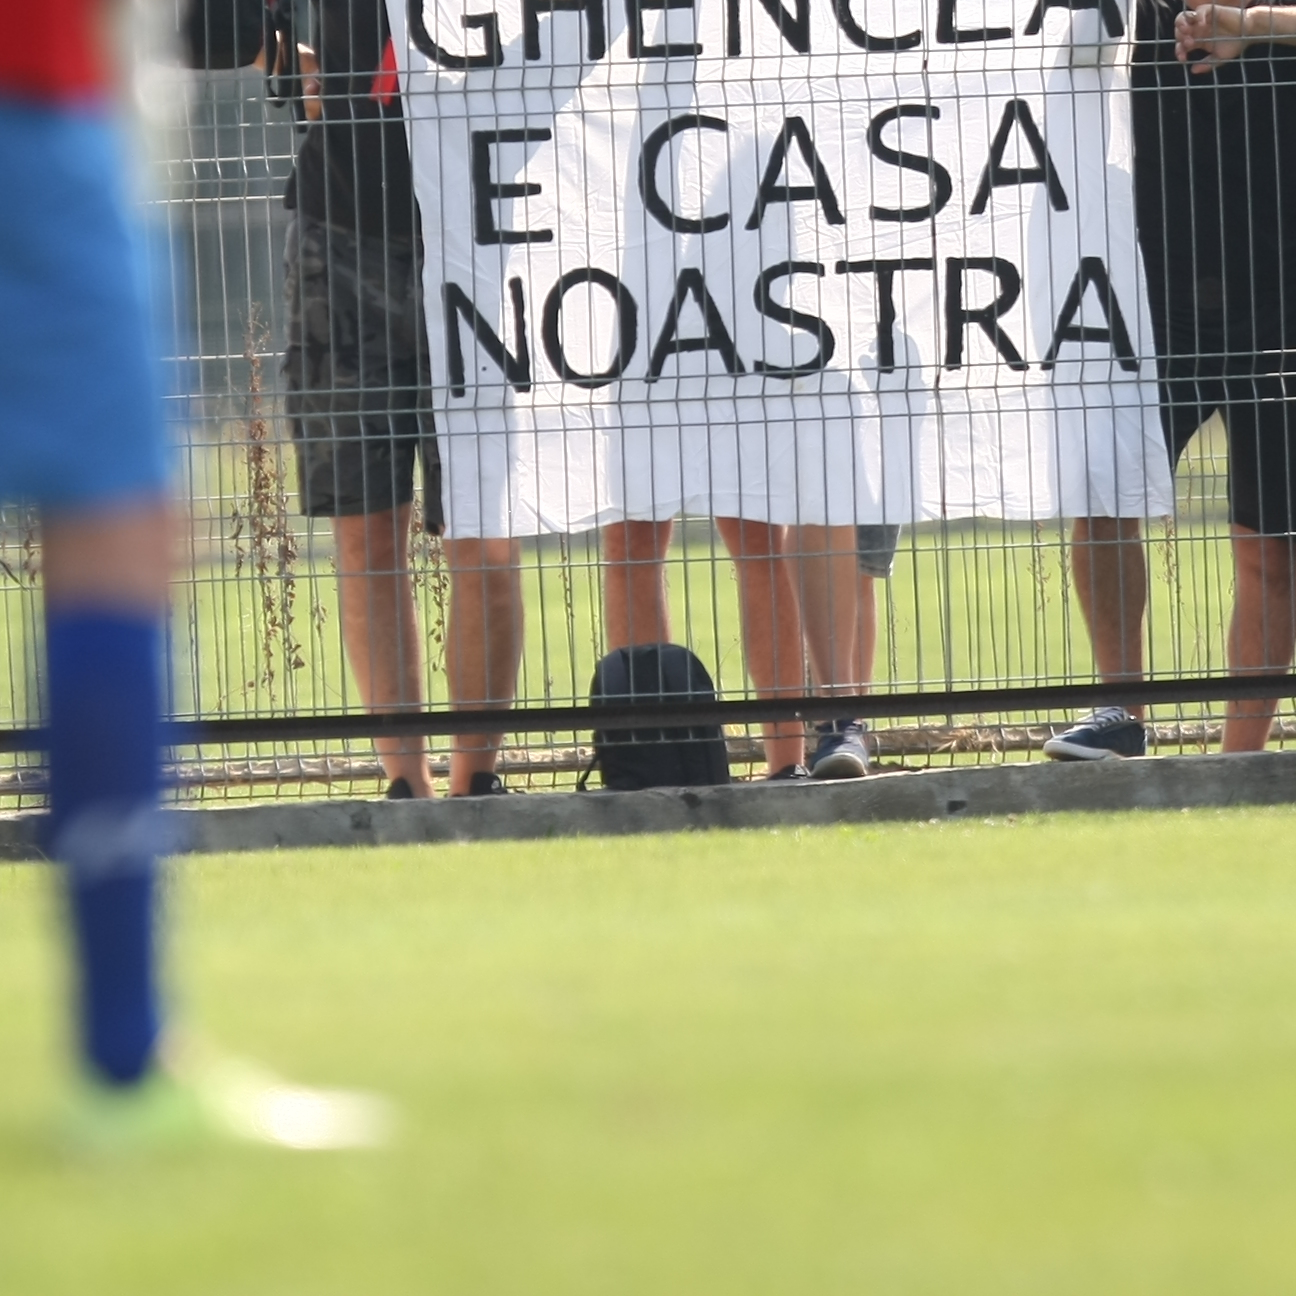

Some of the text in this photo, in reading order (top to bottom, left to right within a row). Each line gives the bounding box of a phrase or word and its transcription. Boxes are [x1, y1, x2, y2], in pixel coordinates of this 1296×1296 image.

[472, 98, 1068, 246] E CASA
[439, 256, 1140, 398] NOASTRA
